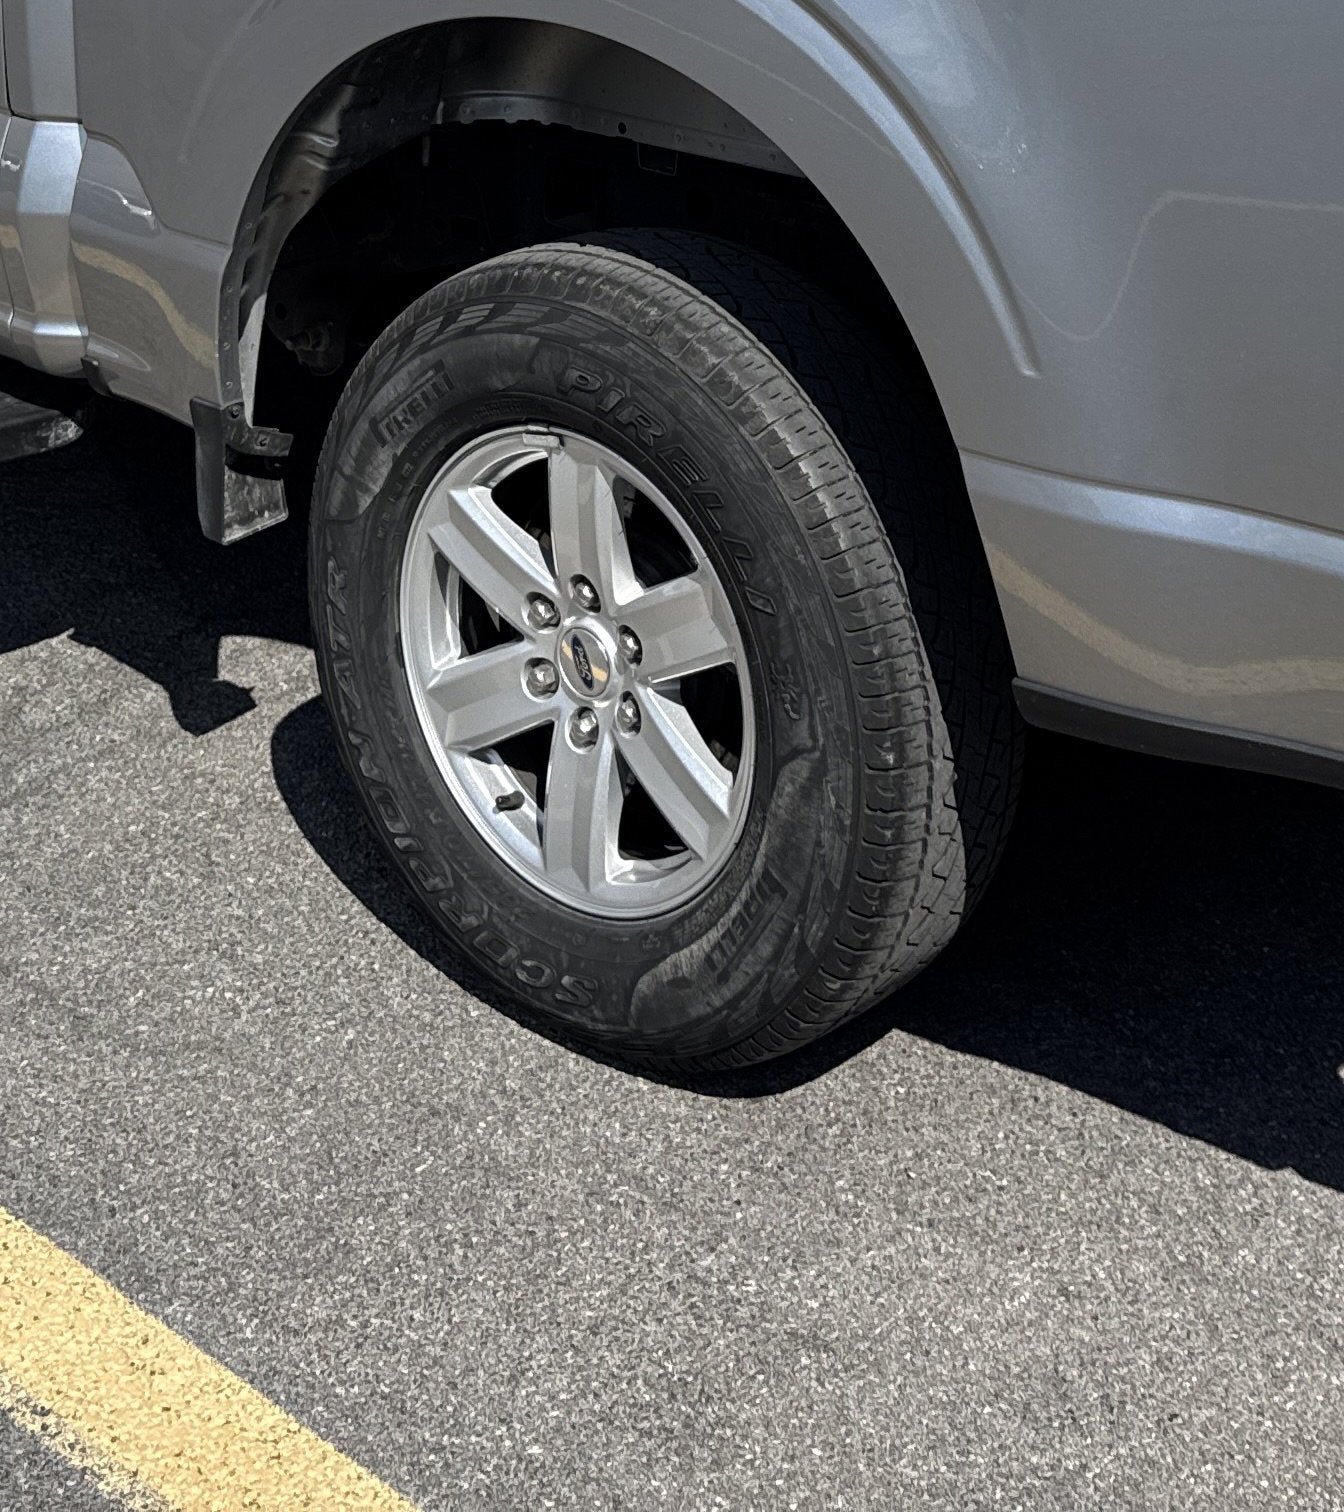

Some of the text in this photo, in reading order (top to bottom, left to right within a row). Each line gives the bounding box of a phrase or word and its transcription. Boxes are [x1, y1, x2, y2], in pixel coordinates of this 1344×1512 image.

[561, 363, 779, 616] PIRELLI
[325, 554, 362, 728] ATR
[347, 729, 599, 1006] SCORPION
